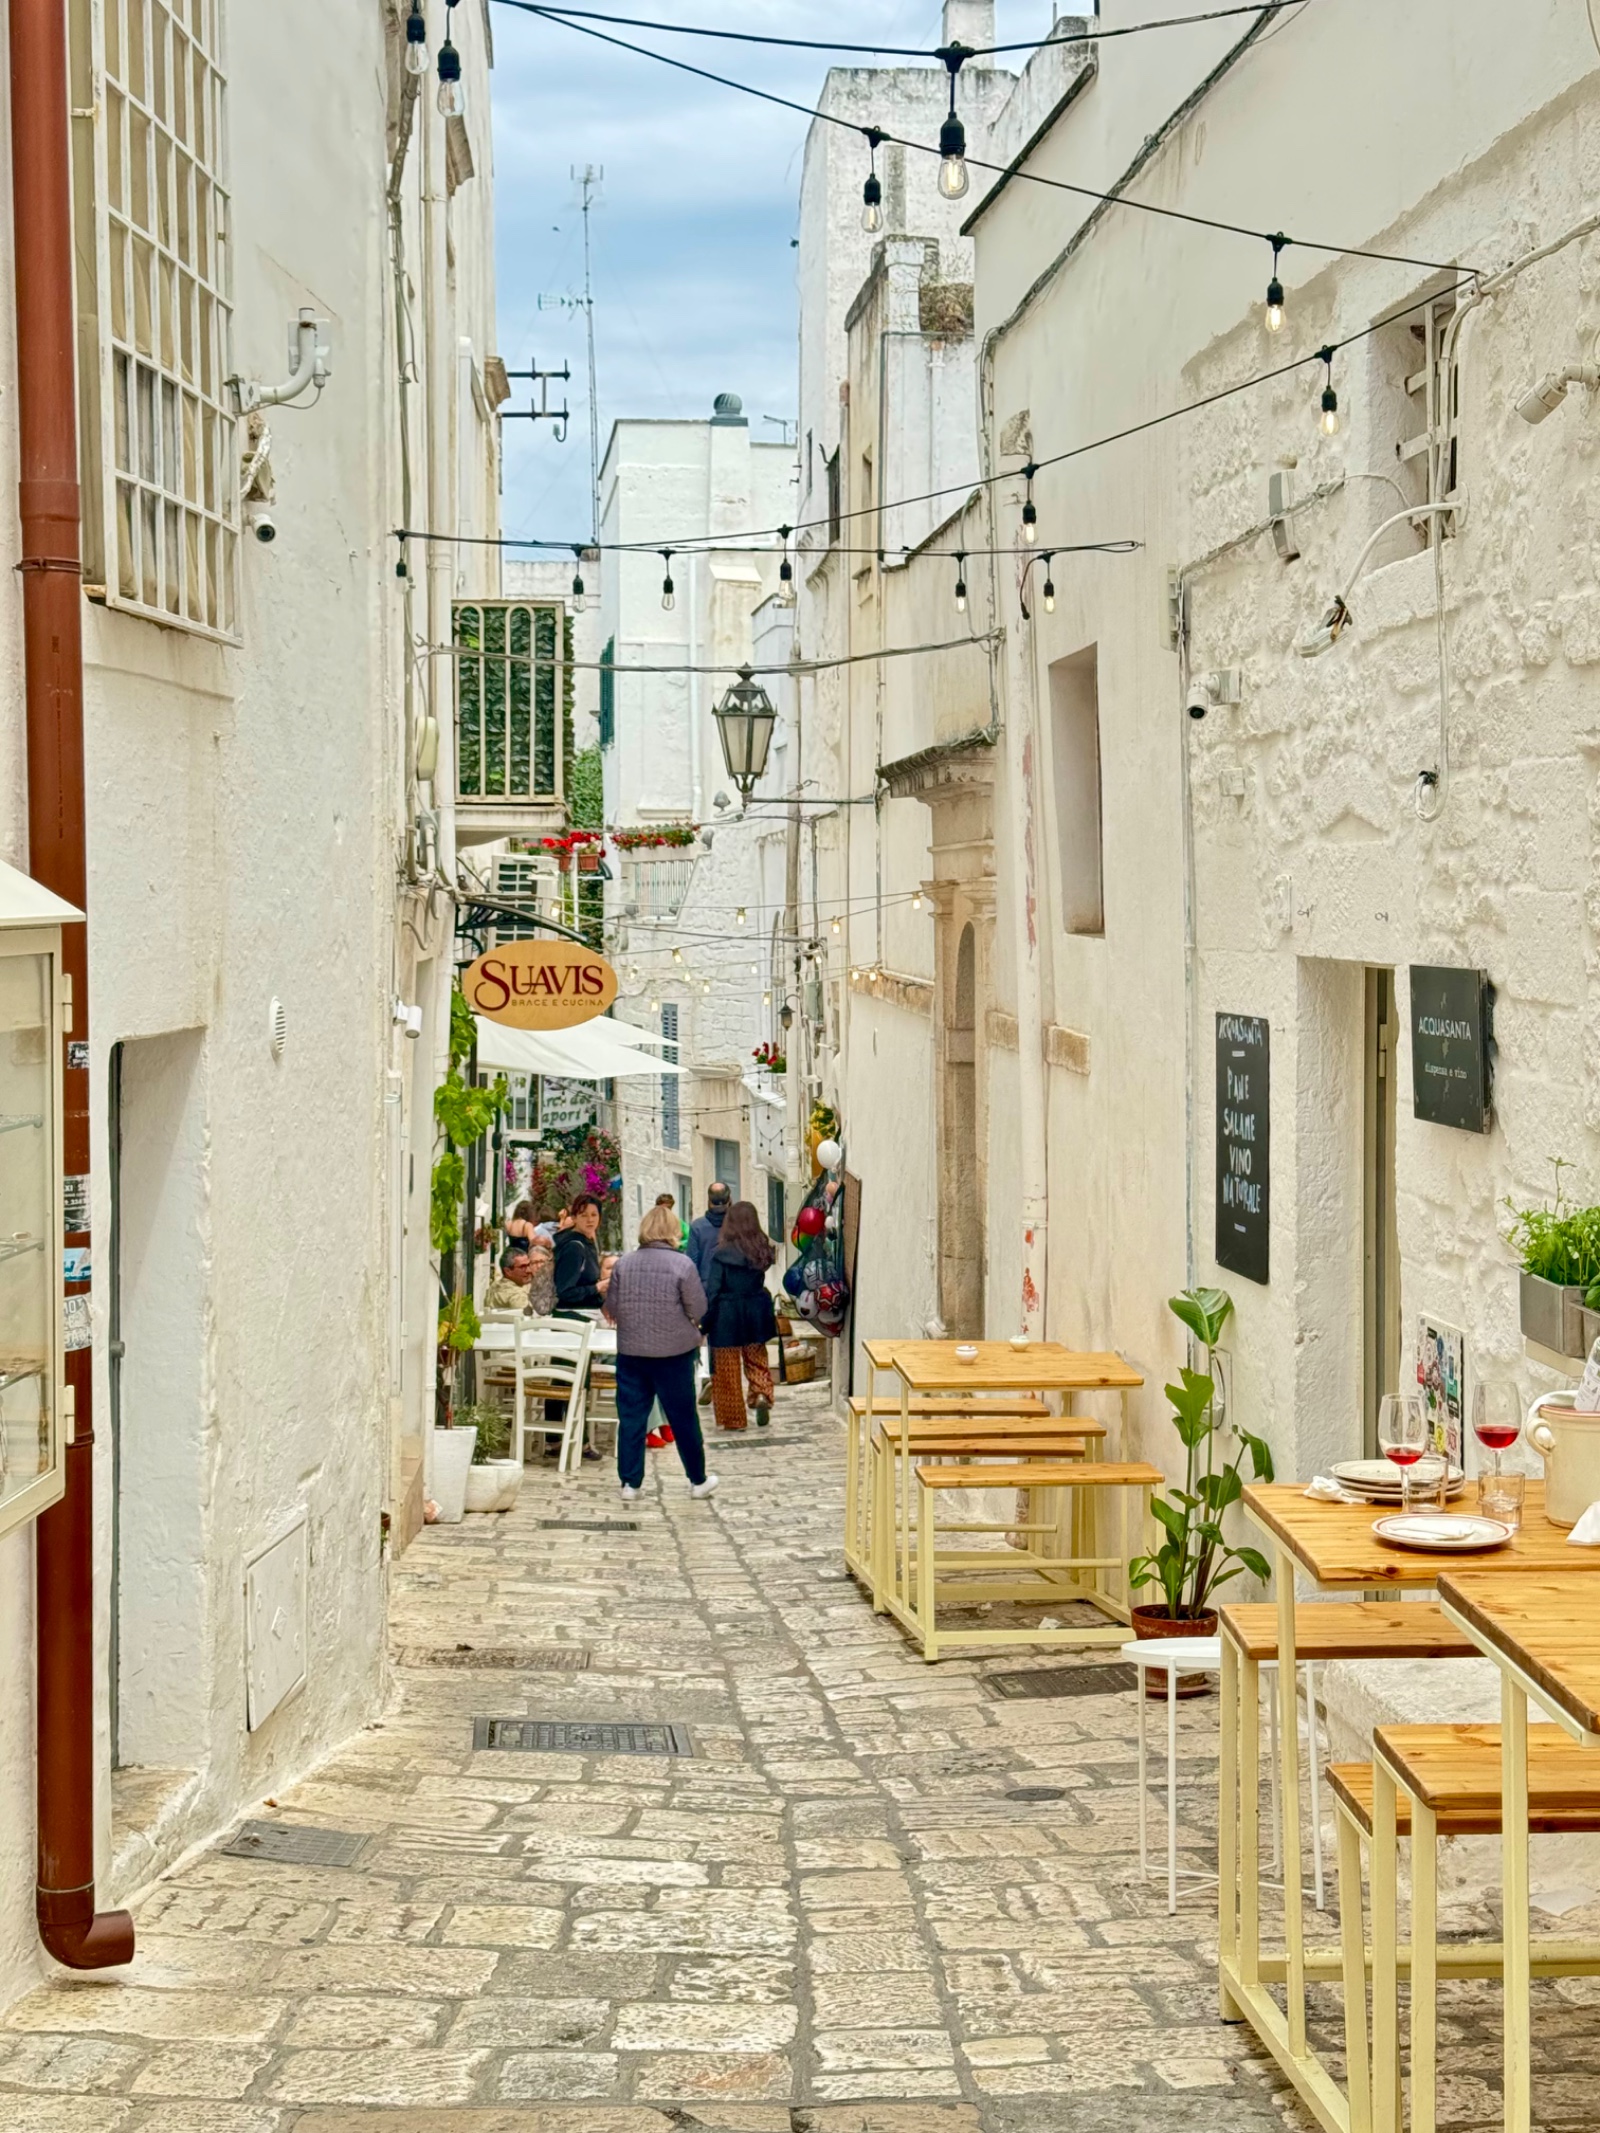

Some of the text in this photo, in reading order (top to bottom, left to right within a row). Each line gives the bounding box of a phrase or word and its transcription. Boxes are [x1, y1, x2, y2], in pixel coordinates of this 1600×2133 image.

[474, 959, 604, 1011] SUAVIS
[511, 999, 604, 1007] BRACE E CUCINA
[1418, 1016, 1472, 1041] ACQUASANTA
[1227, 1065, 1250, 1104] PANE
[542, 1108, 581, 1126] apori
[1223, 1108, 1255, 1142] SALAME
[1229, 1144, 1251, 1175] VINO
[1223, 1174, 1261, 1213] NATURALE
